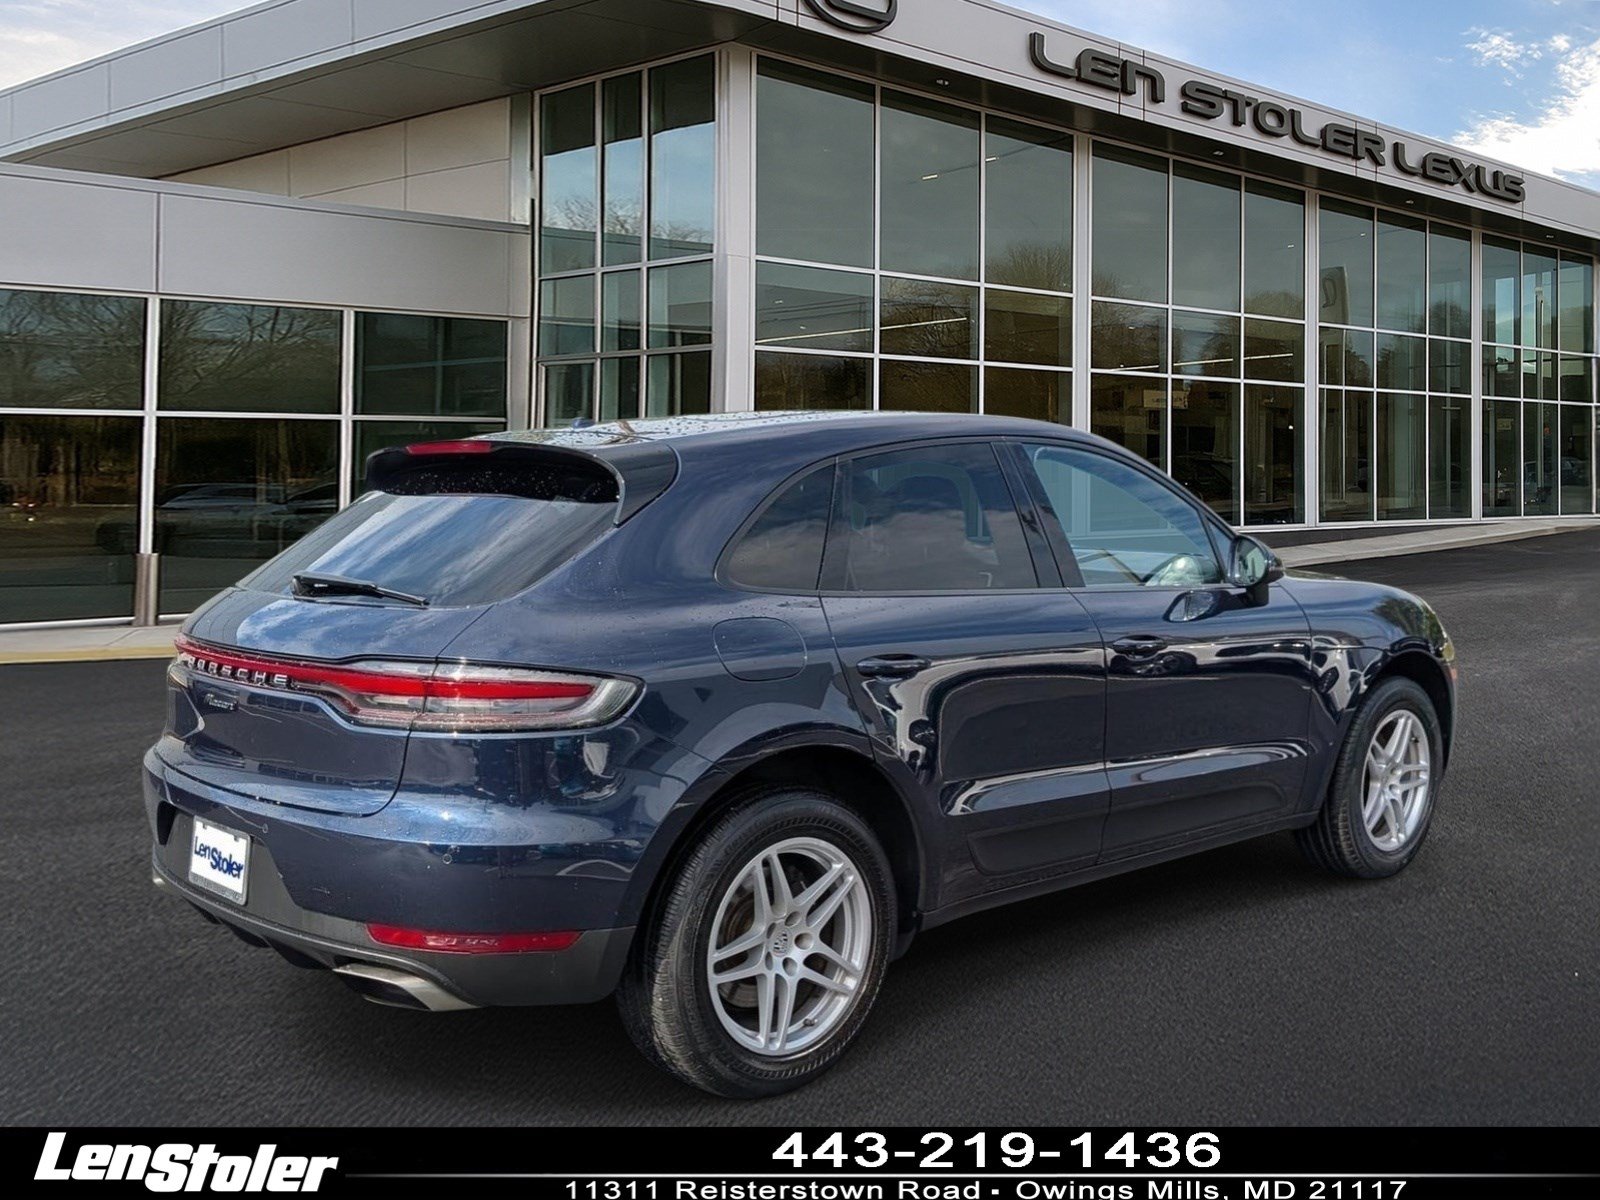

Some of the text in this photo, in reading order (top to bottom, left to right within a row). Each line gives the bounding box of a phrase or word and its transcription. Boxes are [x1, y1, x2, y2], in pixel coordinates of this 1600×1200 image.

[1180, 80, 1386, 167] STOLER
[1393, 142, 1525, 203] LEXUS
[187, 655, 289, 686] PORSCHE
